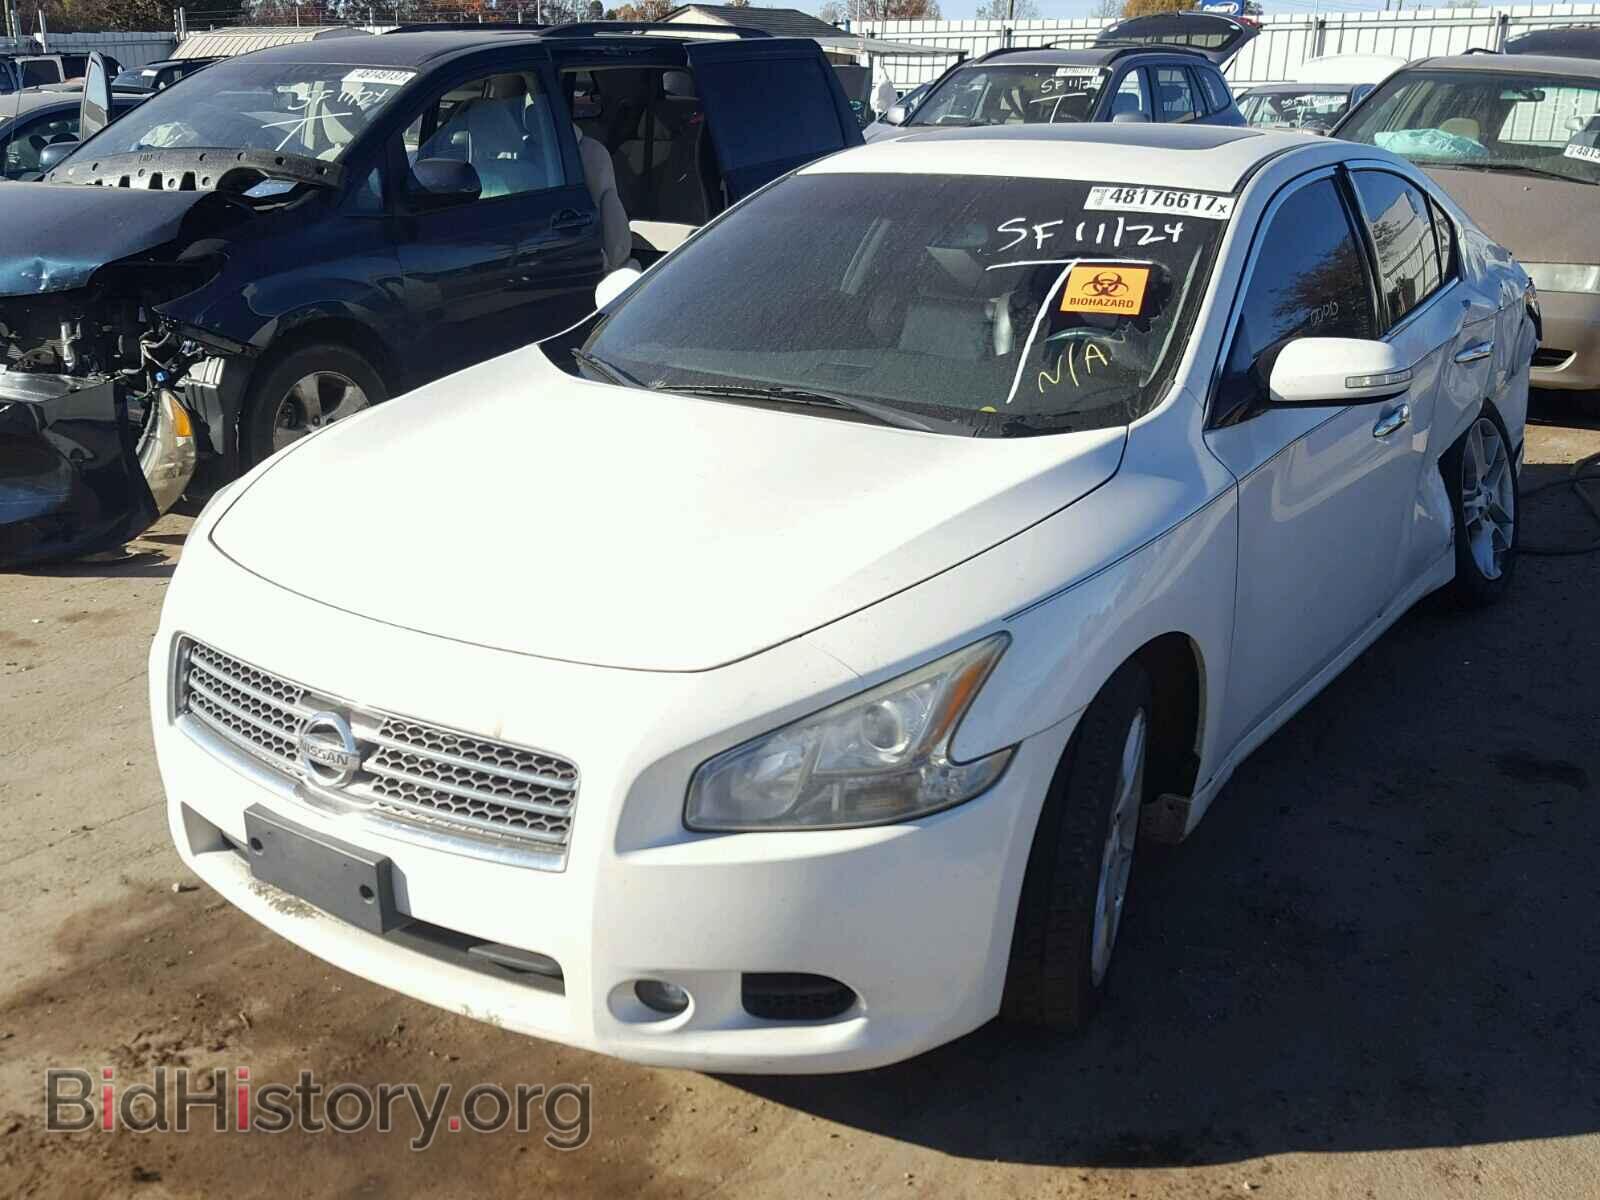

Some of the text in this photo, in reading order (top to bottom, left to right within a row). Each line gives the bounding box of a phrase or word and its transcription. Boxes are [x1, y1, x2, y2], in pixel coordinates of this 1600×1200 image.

[1041, 78, 1064, 93] SF
[996, 217, 1184, 251] SF 11/24
[1069, 297, 1134, 309] BIOHAZARD
[1038, 342, 1109, 393] N/A
